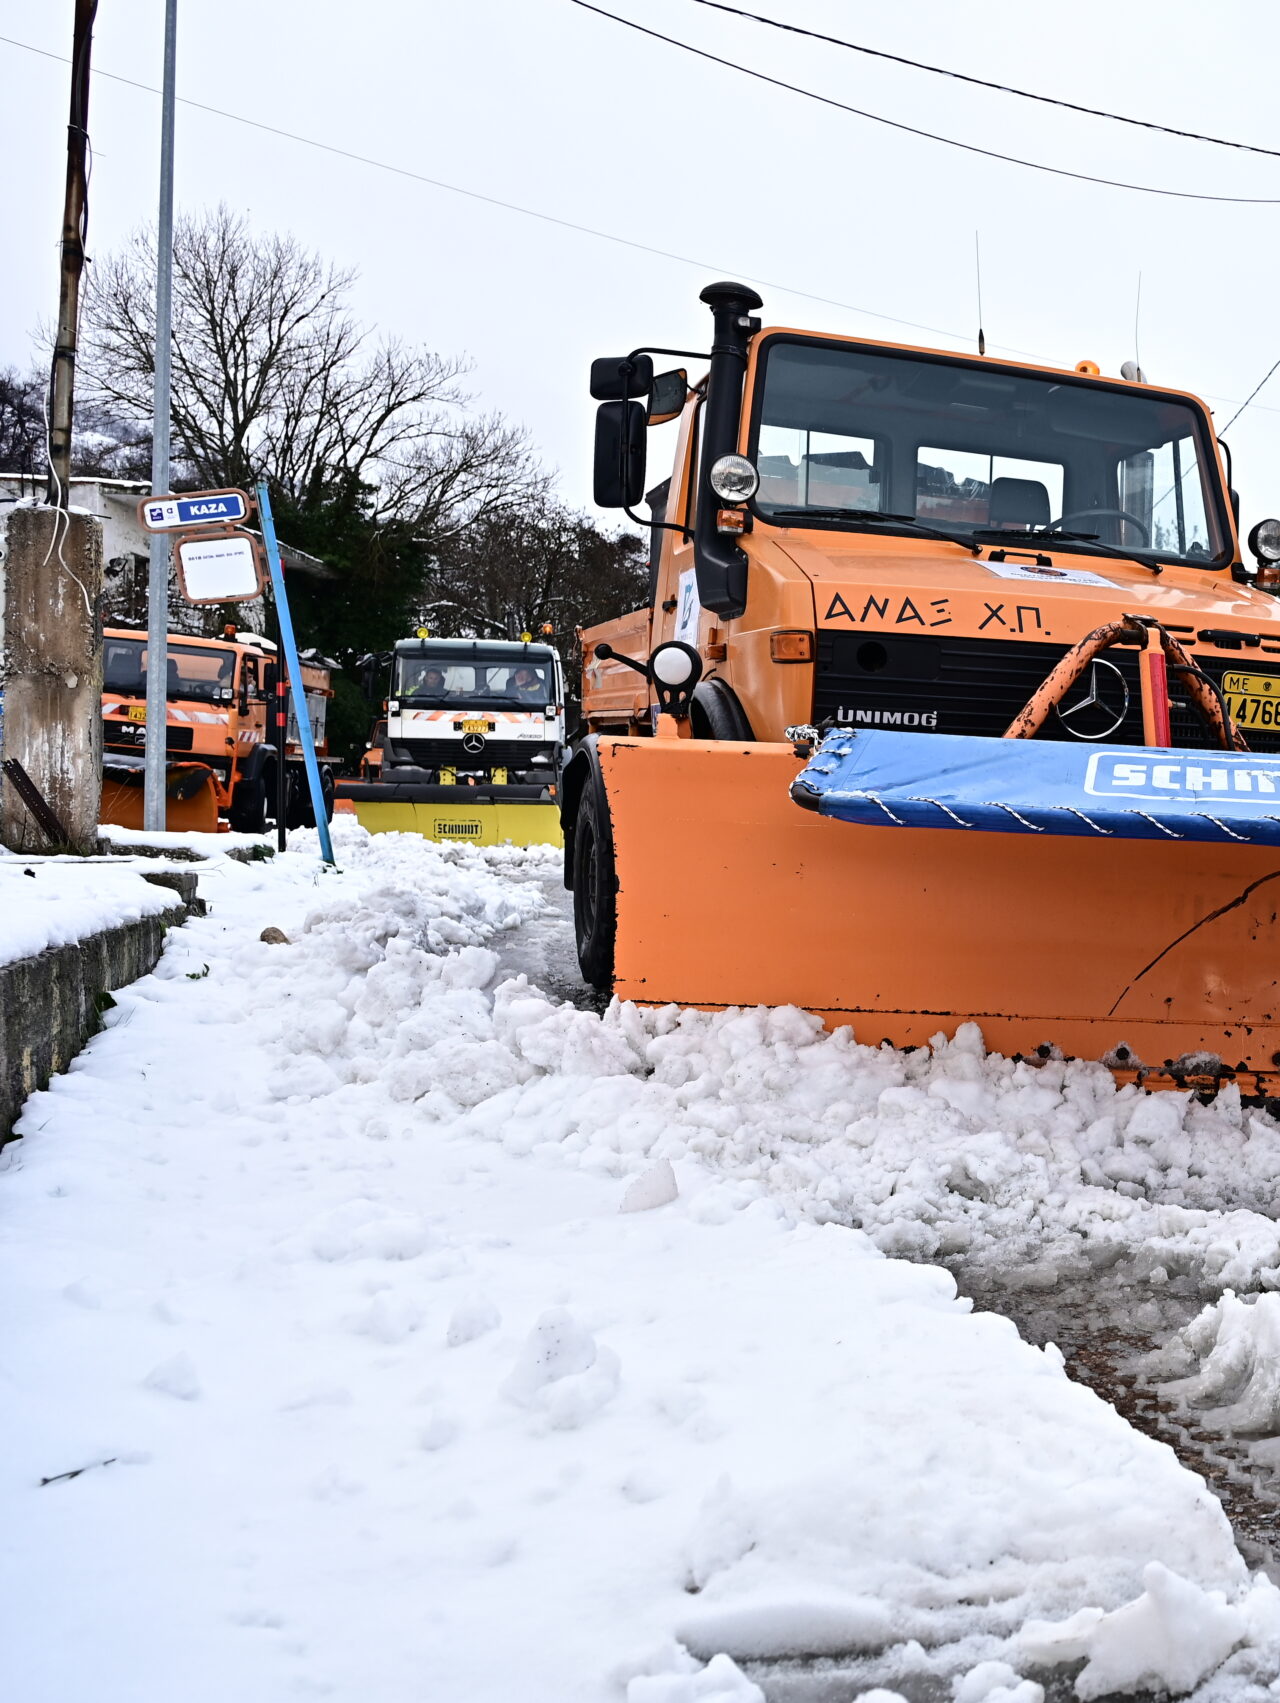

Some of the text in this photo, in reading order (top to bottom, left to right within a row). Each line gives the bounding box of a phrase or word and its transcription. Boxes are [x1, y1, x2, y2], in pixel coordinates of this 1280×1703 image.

[189, 502, 228, 516] ΚΑΖΑ
[824, 591, 1051, 636] ΑΝΑΞ Χ.Π.
[837, 706, 938, 729] UNIMOG
[121, 725, 147, 734] MA
[437, 823, 479, 835] SCHMIDT
